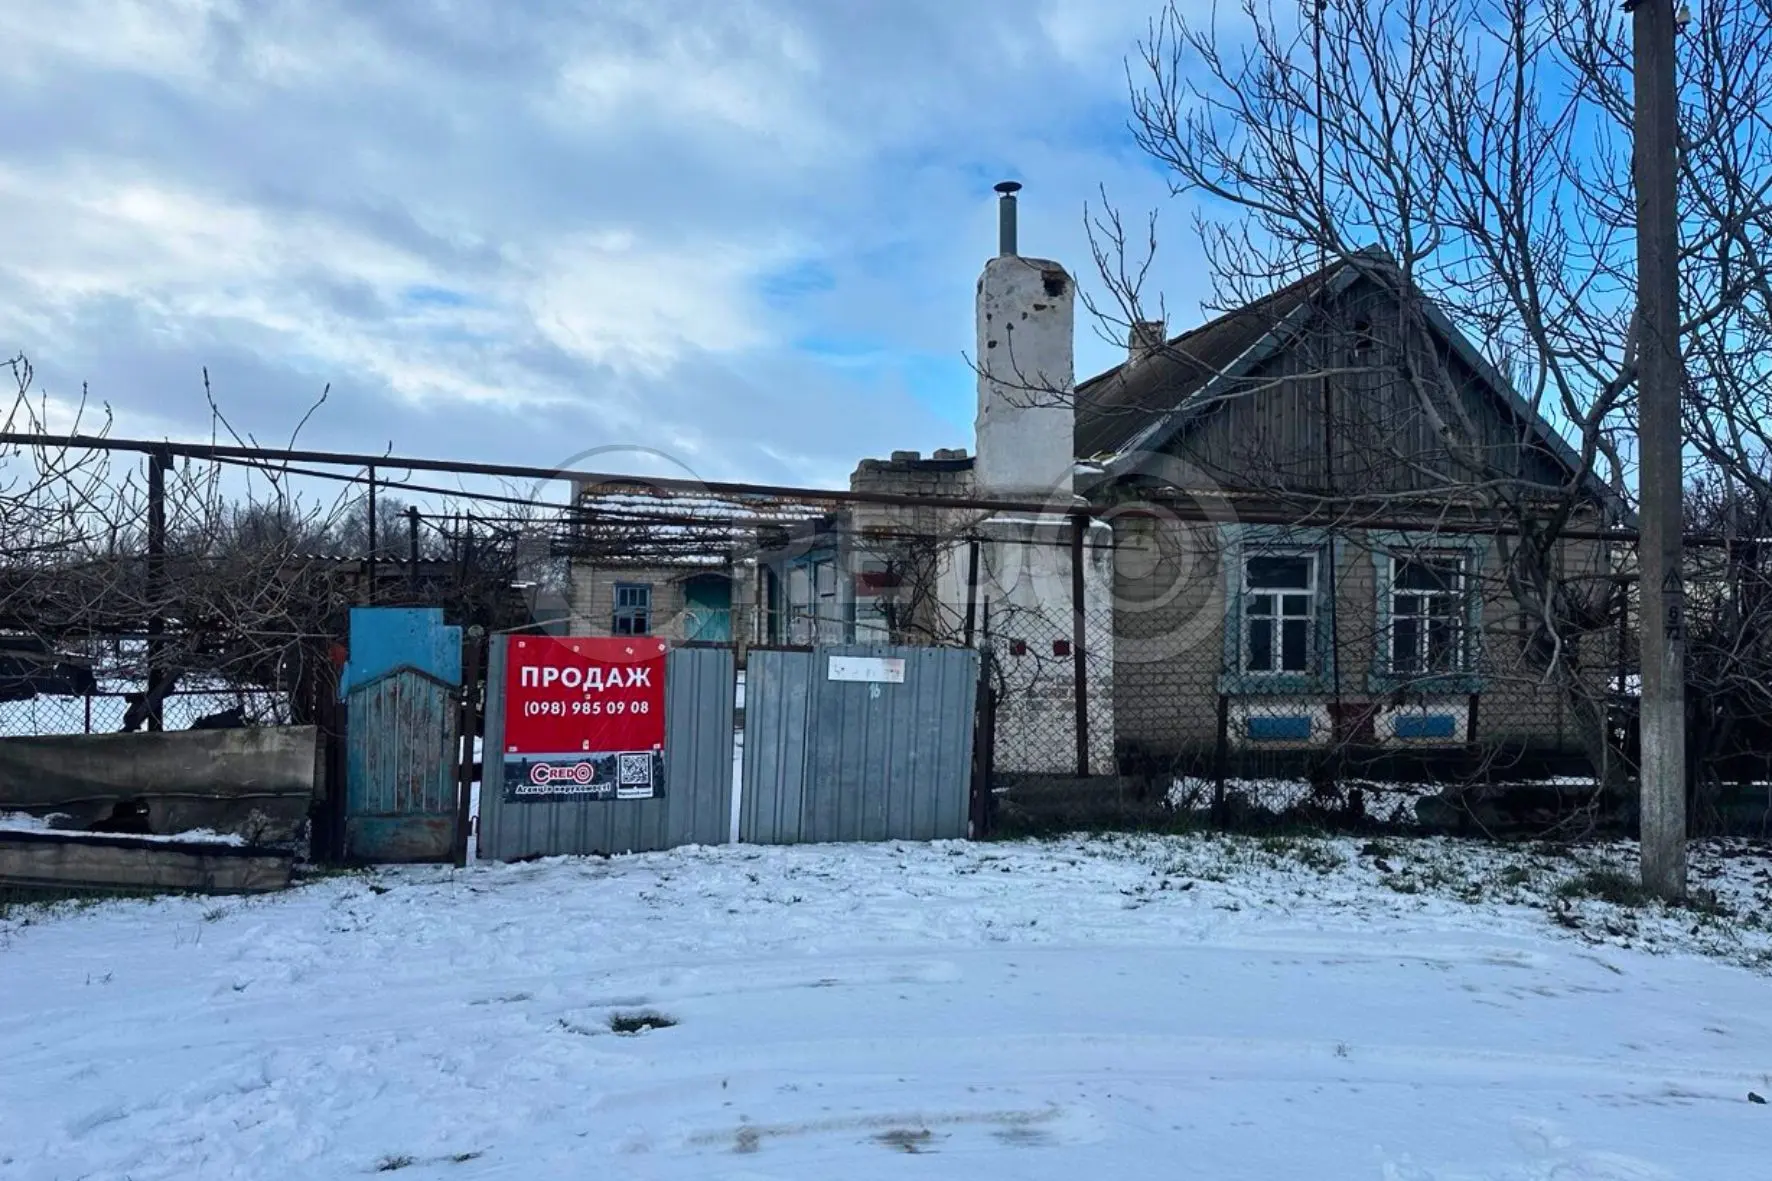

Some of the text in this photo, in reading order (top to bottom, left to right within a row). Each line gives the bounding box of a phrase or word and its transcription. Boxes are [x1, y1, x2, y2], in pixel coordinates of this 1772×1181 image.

[521, 666, 652, 691] ПРОДАЖ
[524, 701, 649, 717] (098) 985 09 08
[531, 763, 593, 783] CREDO
